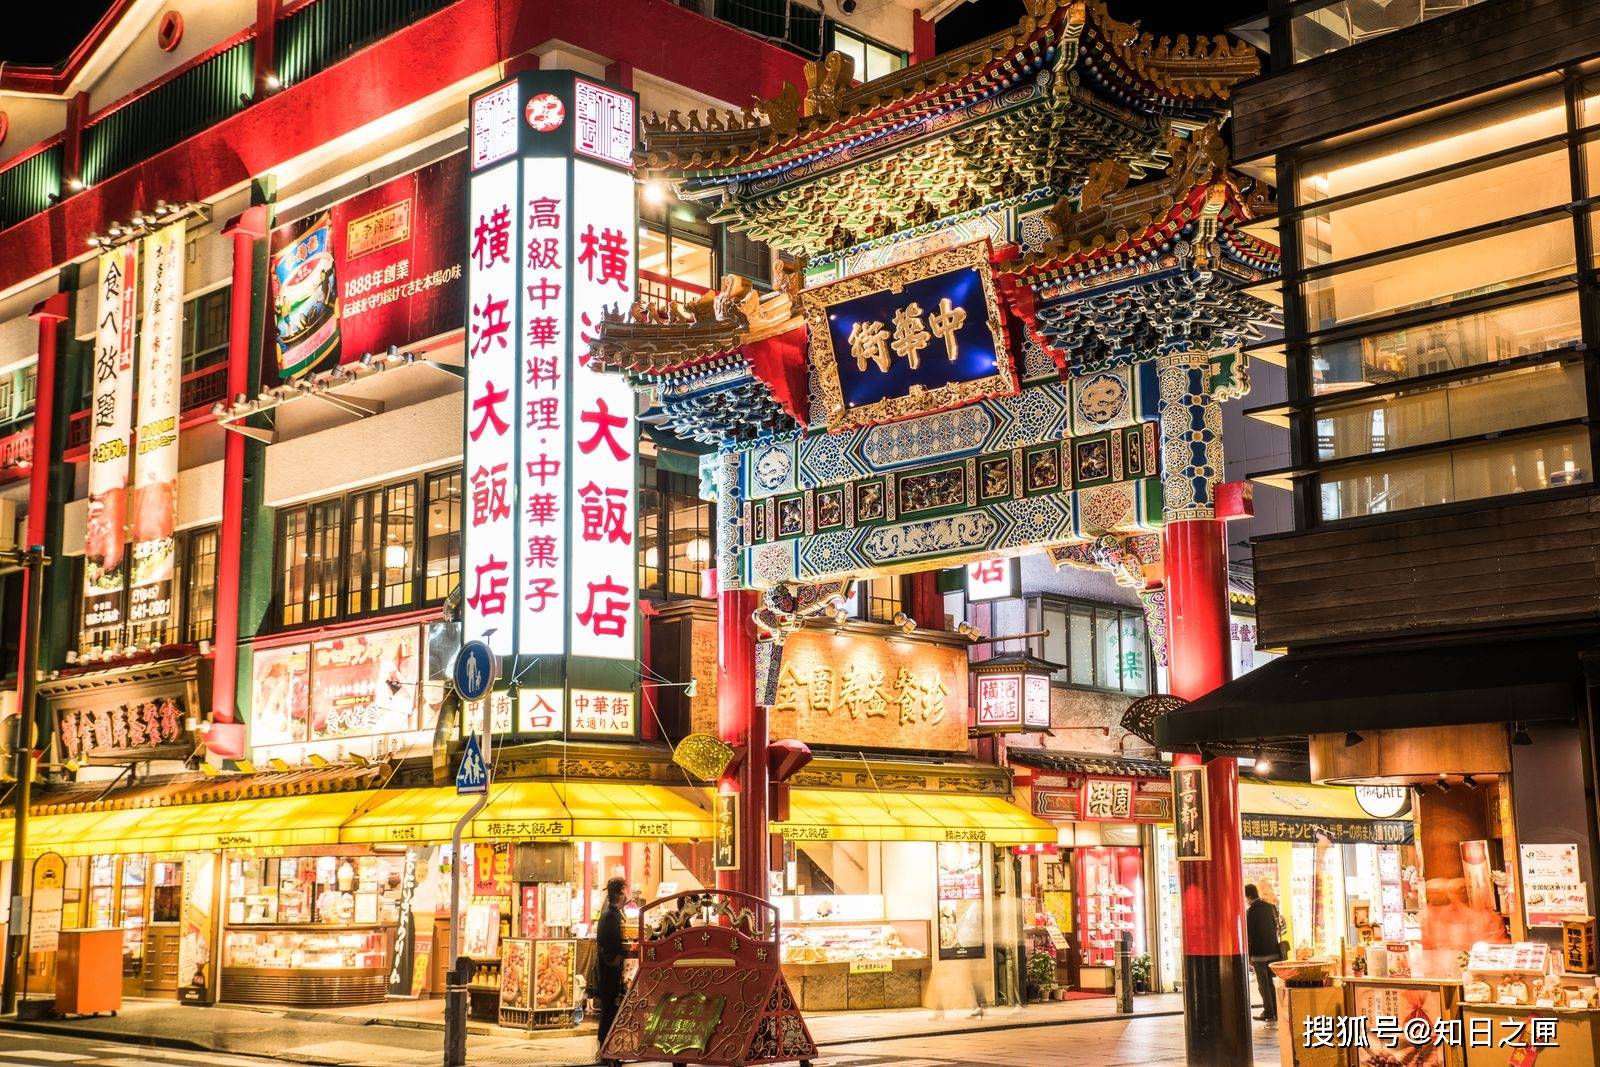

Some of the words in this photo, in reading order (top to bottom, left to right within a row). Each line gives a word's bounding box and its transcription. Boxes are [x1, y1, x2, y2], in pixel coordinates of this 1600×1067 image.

[343, 264, 462, 319] 伝統を守り続けてきた本場の味
[344, 259, 409, 298] 1888年創業
[847, 297, 967, 374] 中華街
[467, 204, 512, 617] 横浜大飯店
[526, 197, 562, 612] 高級中華料理・中華菓子
[576, 224, 633, 638] 横大飯店
[468, 696, 510, 716] 中街
[529, 694, 557, 728] 入口
[575, 695, 630, 717] 中華街
[575, 717, 629, 730] 大通り入口
[487, 821, 564, 836] 横浜大飯店
[780, 827, 829, 841] 横浜大飯店
[945, 829, 986, 841] 横浜大飯店
